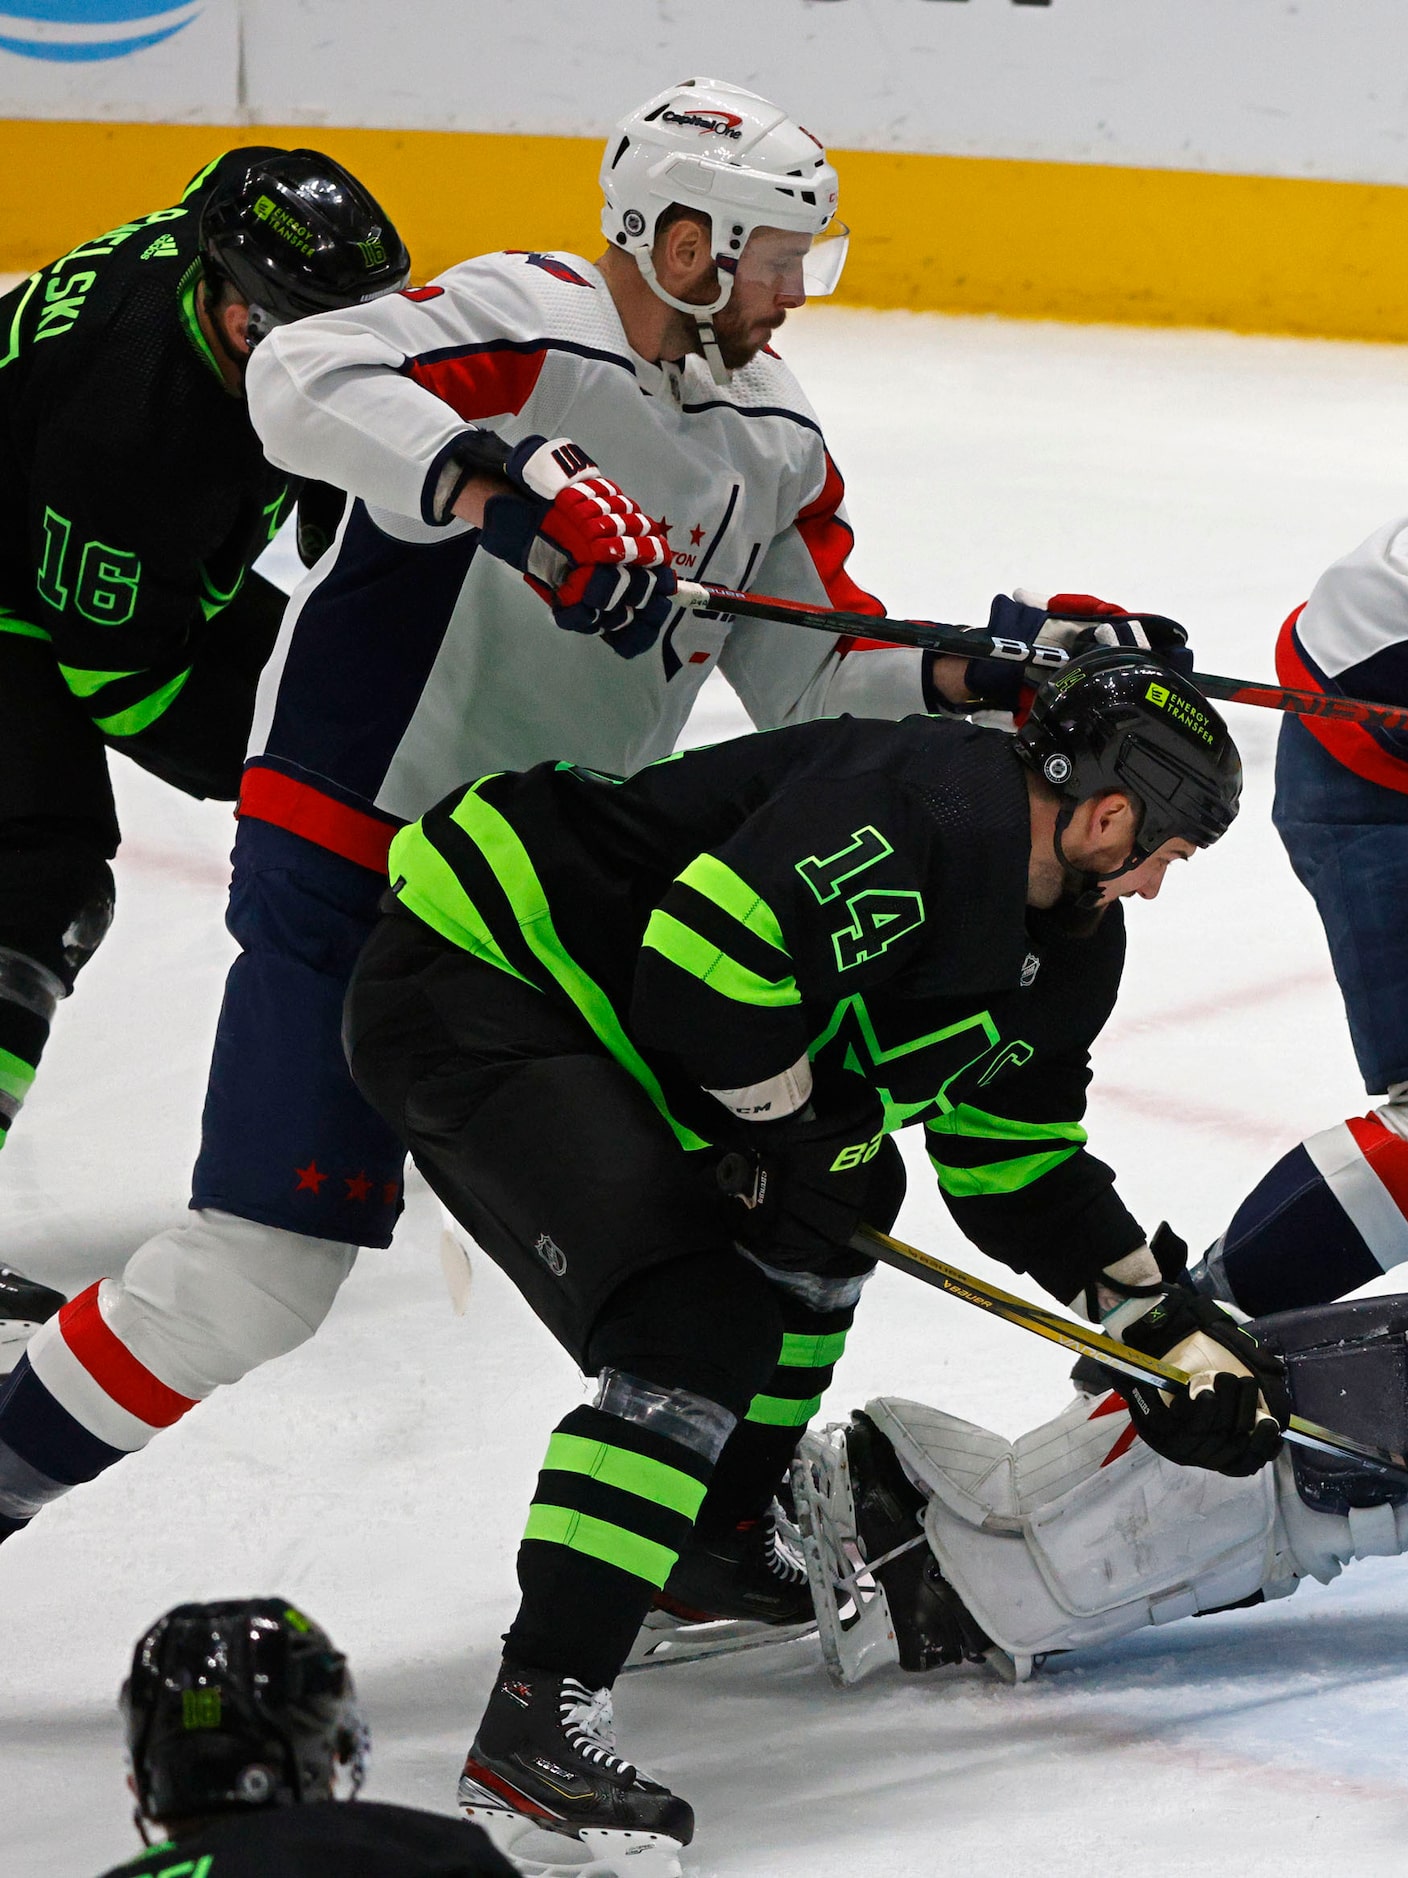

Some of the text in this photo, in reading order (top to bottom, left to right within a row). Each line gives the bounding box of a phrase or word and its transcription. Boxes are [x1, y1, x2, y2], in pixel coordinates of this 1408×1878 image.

[268, 218, 315, 258] TRANSFER
[274, 208, 313, 241] ENERGY
[358, 238, 388, 268] 16
[37, 505, 142, 626] 16
[1167, 702, 1215, 745] TRANSFER
[1170, 693, 1210, 727] ENERGY
[795, 825, 925, 972] 14
[734, 1101, 772, 1114] CM
[950, 1284, 993, 1309] BAUER
